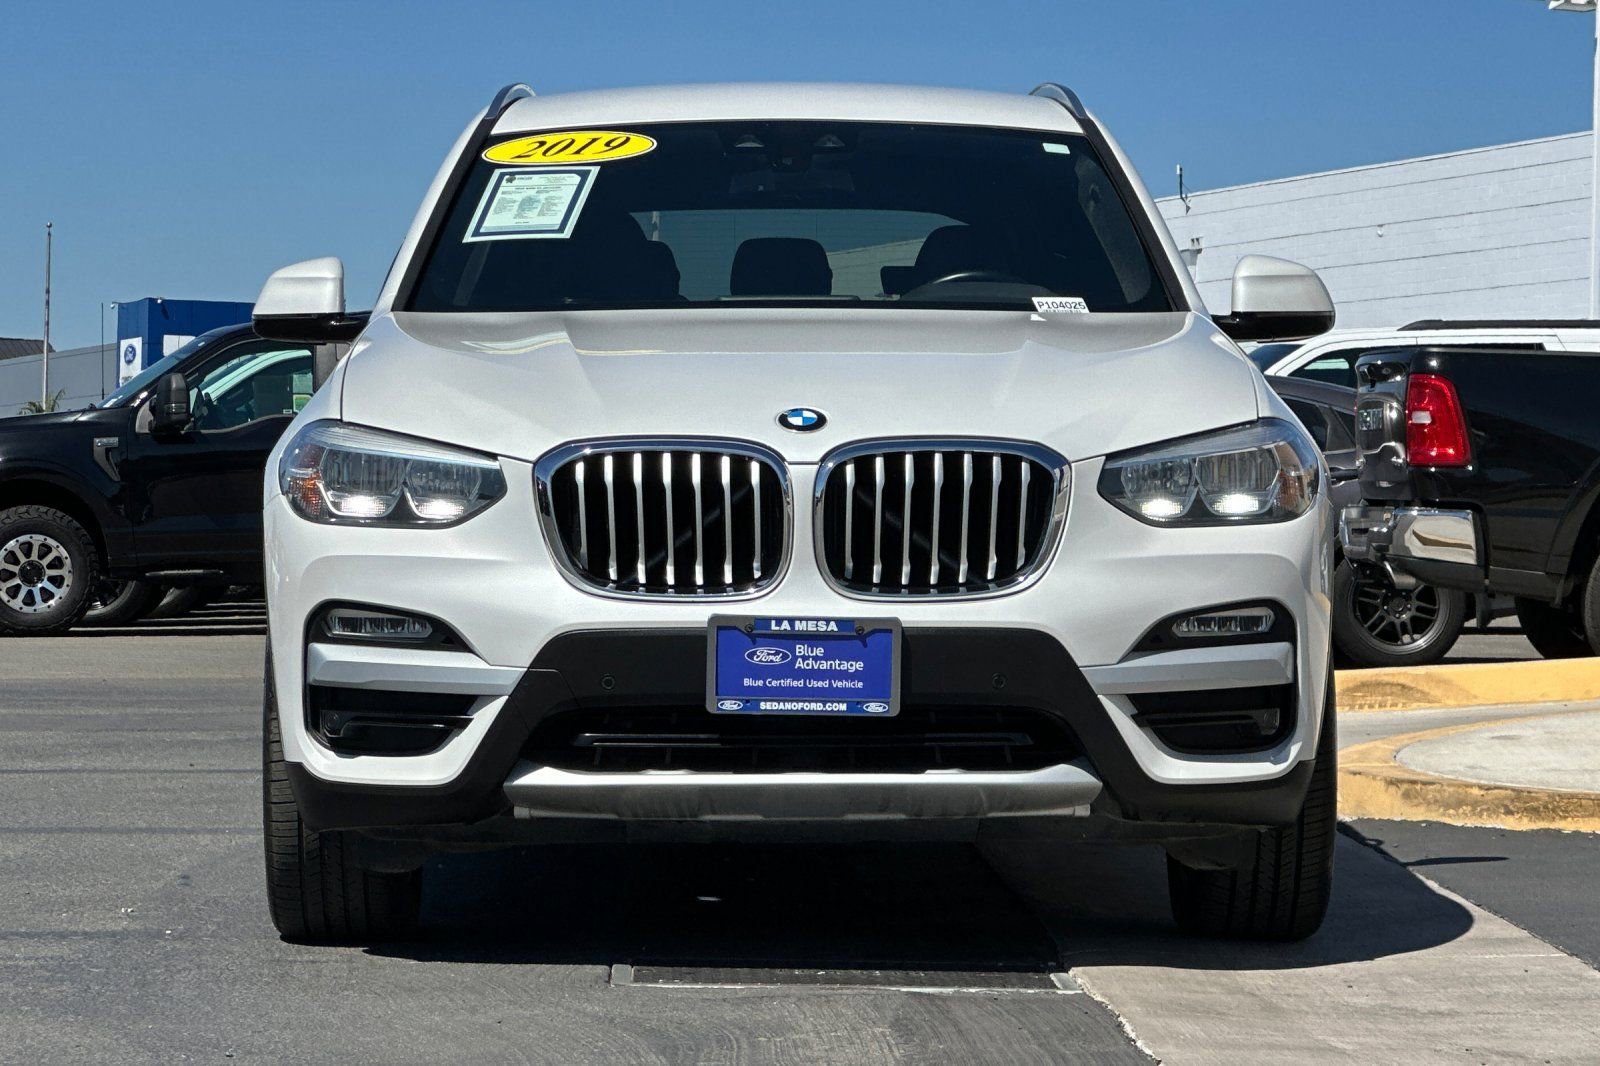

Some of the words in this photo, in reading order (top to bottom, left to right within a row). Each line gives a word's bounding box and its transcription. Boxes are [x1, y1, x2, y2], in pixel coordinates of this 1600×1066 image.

[510, 136, 631, 160] 2019
[1036, 301, 1086, 310] P104025
[770, 619, 791, 631] LA
[794, 620, 839, 632] MESA
[753, 648, 783, 663] Ford
[795, 644, 825, 656] Blue
[794, 657, 864, 673] Advantage
[743, 678, 764, 687] Blue
[765, 678, 804, 688] Certified
[806, 679, 829, 688] Used
[832, 679, 864, 689] Vehicle
[759, 701, 847, 711] SEDANOFORD.COM
